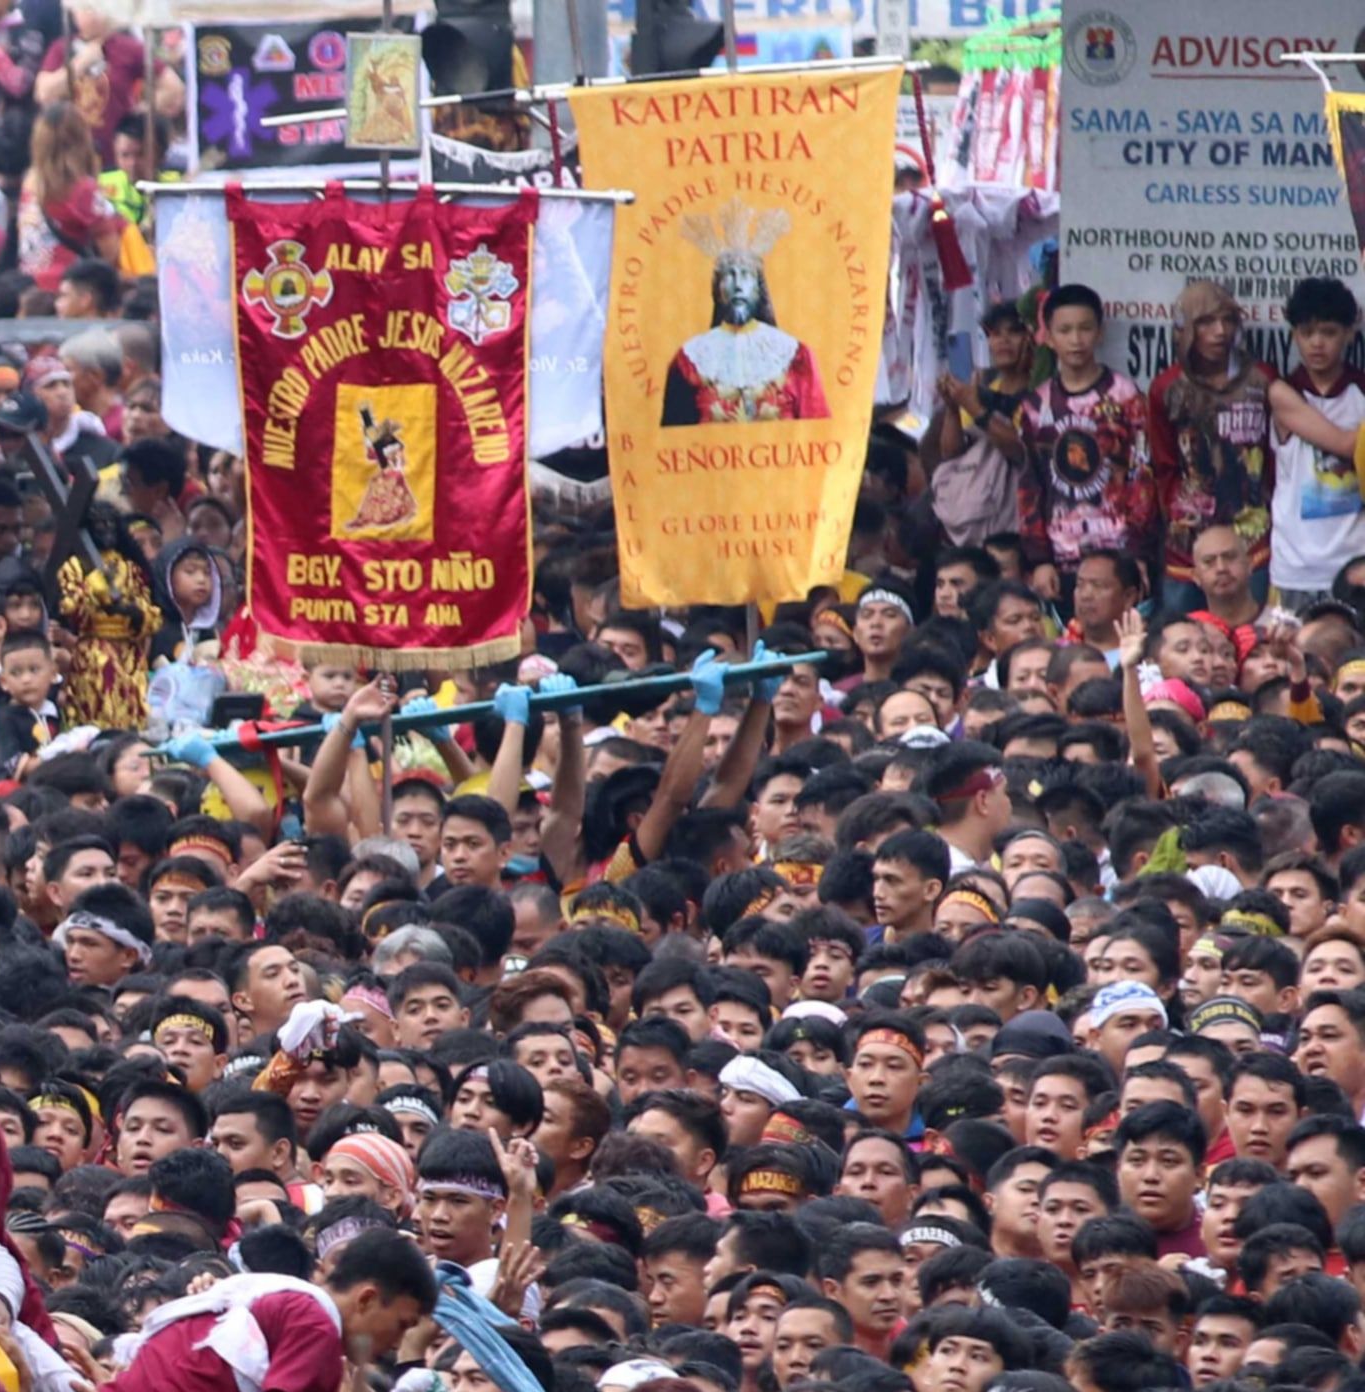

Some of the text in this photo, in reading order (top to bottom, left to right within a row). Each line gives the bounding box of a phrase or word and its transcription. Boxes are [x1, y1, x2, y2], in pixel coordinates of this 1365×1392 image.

[1151, 37, 1336, 69] ADVISORY
[611, 83, 858, 129] KAPATIRAN
[1070, 108, 1150, 134] SAMA
[1175, 110, 1246, 135] SAYA
[1252, 113, 1287, 135] SA
[664, 131, 813, 168] PATRIA
[1123, 141, 1197, 165] CITY
[1206, 142, 1250, 166] OF
[1145, 184, 1340, 207] CARLESS SUNDAY
[1066, 228, 1214, 249] NORTHBOUND
[1220, 230, 1265, 250] AND
[324, 242, 434, 274] ALAY SA
[1127, 252, 1359, 277] OF ROXAS BOULEVARD
[619, 171, 868, 399] NUESTRO PADRE HESUS NAZARENO
[262, 311, 512, 470] NUESTRO PADRE JESUS NAZARENO
[661, 514, 745, 537] GLOBE
[715, 538, 797, 561] HOUSE
[287, 553, 342, 588] BGY.
[362, 559, 423, 592] STO
[290, 597, 462, 627] PUNTA STA ANA
